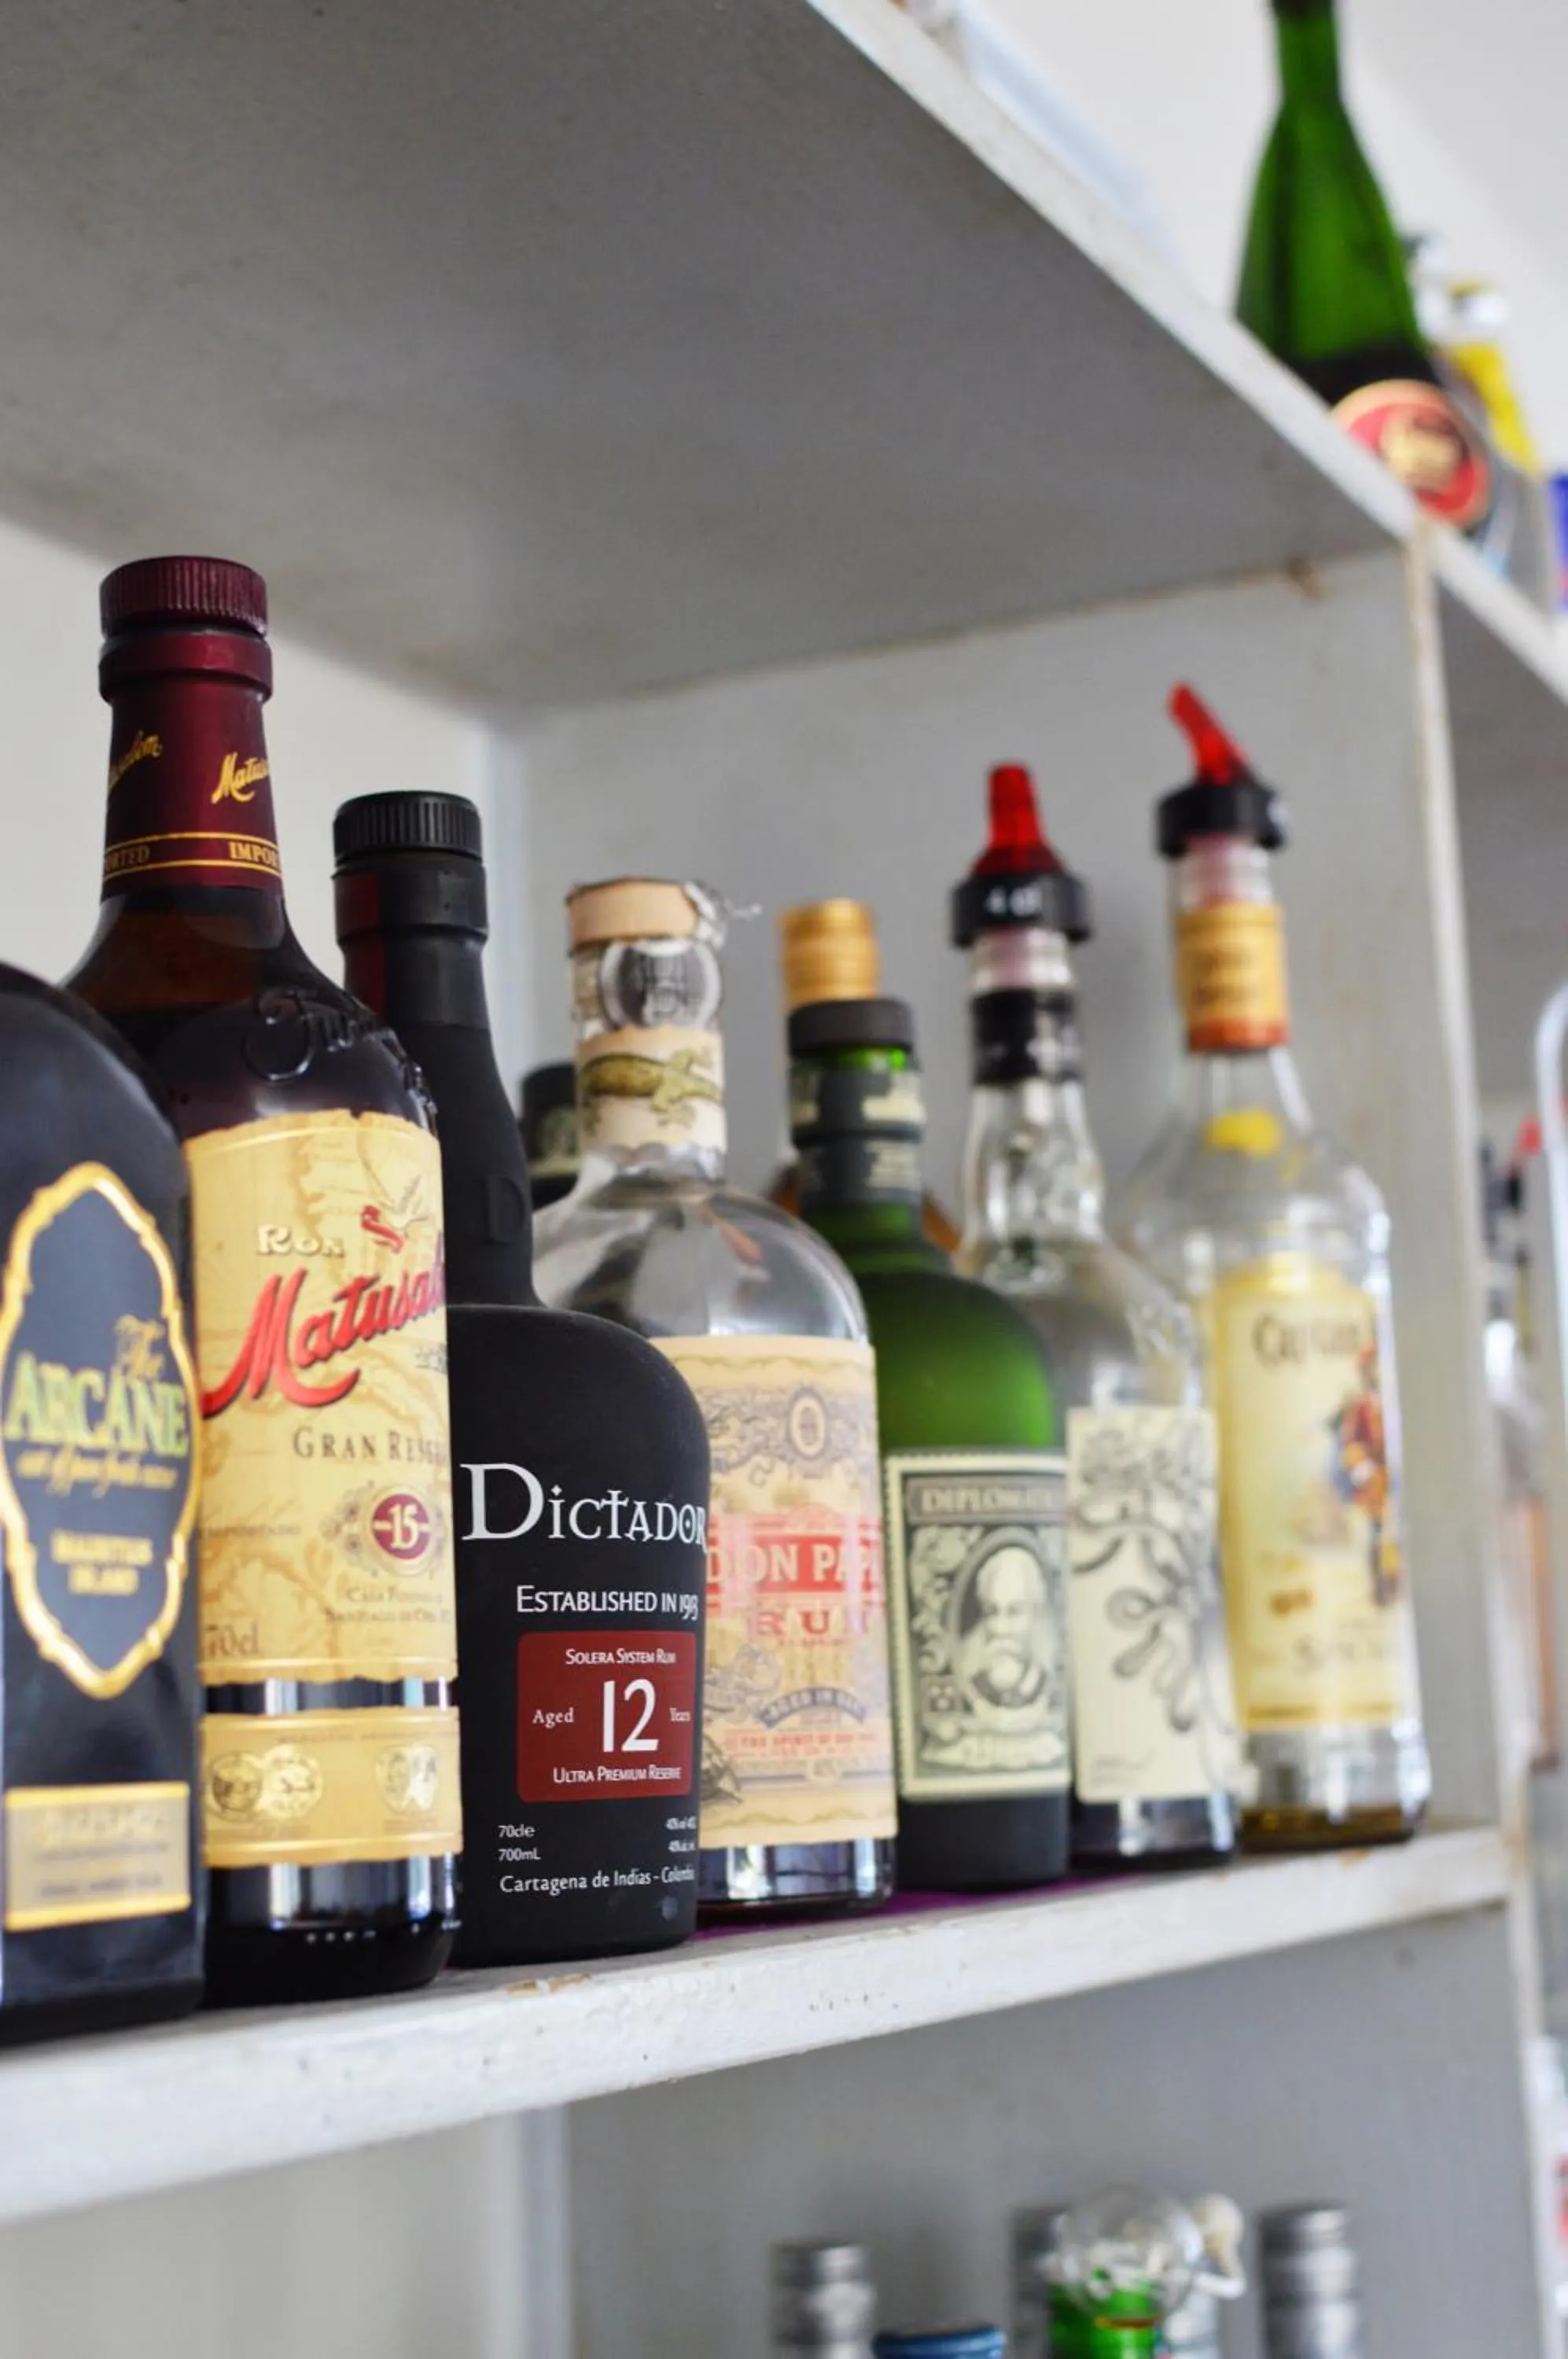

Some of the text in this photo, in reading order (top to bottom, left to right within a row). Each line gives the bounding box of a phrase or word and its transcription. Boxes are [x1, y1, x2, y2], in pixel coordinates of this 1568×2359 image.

[2, 1351, 189, 1458] ARCANE
[293, 1426, 377, 1459] GRAN
[516, 1584, 658, 1613] ESTABLISHED
[661, 1592, 677, 1612] IN
[565, 1647, 676, 1665] SOLERA SYSTEM RUM
[532, 1706, 575, 1729] Aged
[602, 1678, 660, 1753] 12
[552, 1767, 594, 1783] ULTRA
[597, 1765, 647, 1782] PREMIUM
[499, 1875, 588, 1896] Cartagena
[591, 1869, 610, 1888] de
[613, 1868, 652, 1886] Indias
